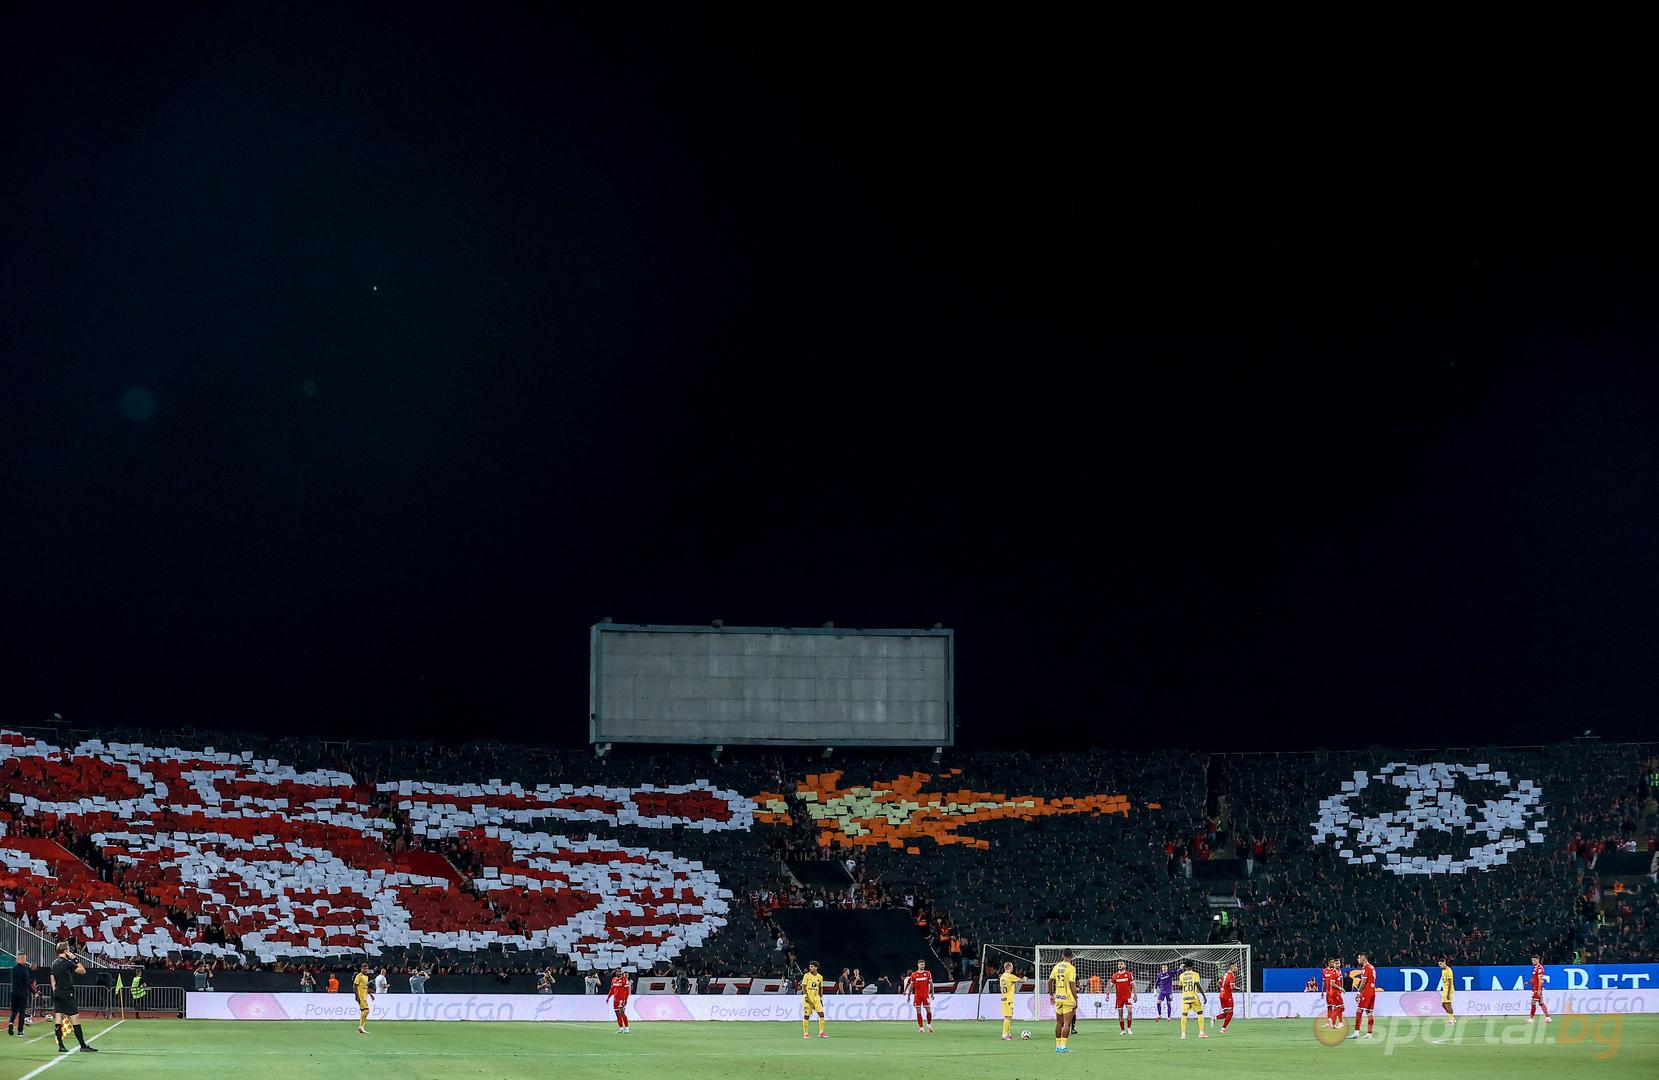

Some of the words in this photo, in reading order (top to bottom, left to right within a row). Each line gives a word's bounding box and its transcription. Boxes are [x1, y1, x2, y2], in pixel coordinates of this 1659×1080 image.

[1563, 968, 1650, 990] BET
[372, 1003, 390, 1019] by
[396, 995, 514, 1020] ultrafan
[710, 1003, 771, 1017] Powered
[775, 1004, 793, 1020] by
